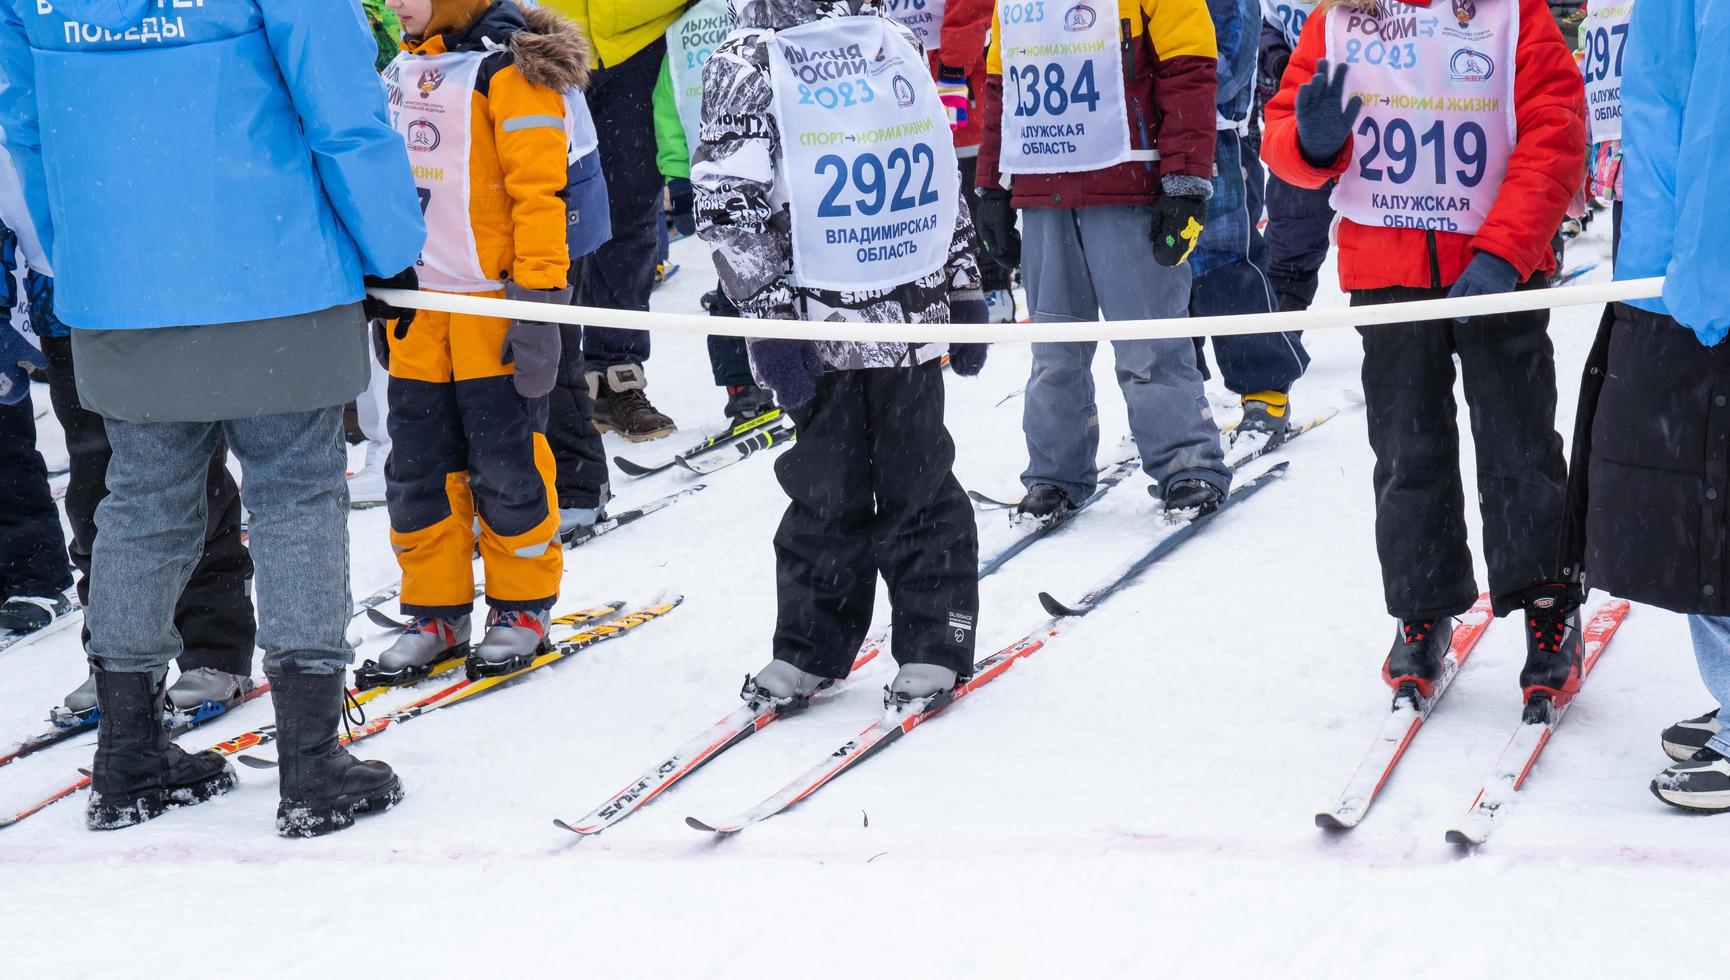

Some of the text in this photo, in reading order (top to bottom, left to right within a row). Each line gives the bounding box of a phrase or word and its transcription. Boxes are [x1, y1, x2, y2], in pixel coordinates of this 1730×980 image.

[1003, 2, 1044, 25] 2023
[1026, 45, 1061, 57] НОРМА
[1061, 40, 1105, 55] ЖИЗНИ
[1346, 38, 1417, 70] 2023
[798, 78, 875, 109] 2023
[1390, 94, 1444, 110] НОРМА
[1448, 97, 1499, 113] ЖИЗНИ
[799, 117, 935, 146] СПОРТ НОРМА ЖИЗНИ
[1022, 141, 1077, 155] ОБЛАСТЬ
[1357, 115, 1487, 188] 2919
[814, 142, 939, 218] 2922
[1372, 192, 1470, 211] КАЛУЖСКАЯ
[825, 214, 937, 245] ВЛАДИМИРСКАЯ
[1383, 214, 1458, 232] ОБЛАСТЬ
[856, 239, 918, 263] ОБЛАСТЬ
